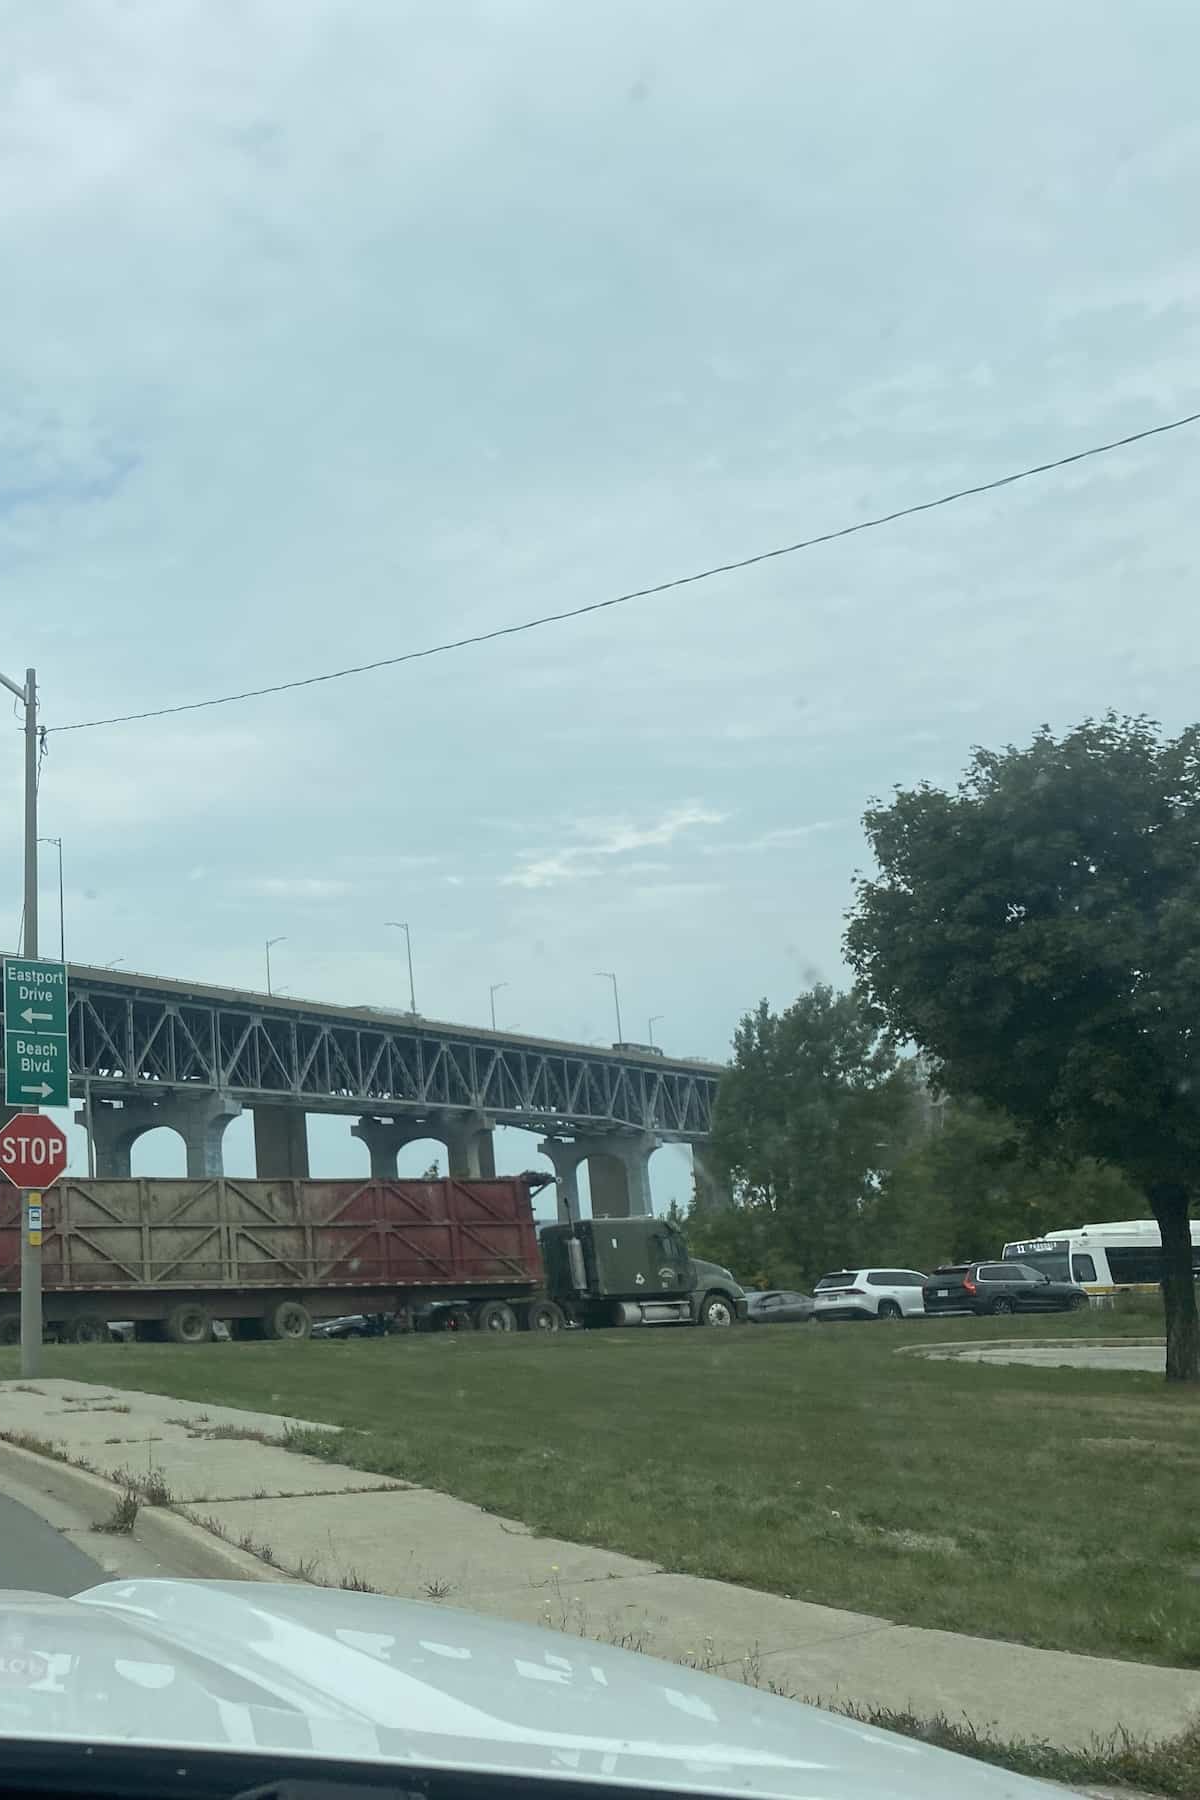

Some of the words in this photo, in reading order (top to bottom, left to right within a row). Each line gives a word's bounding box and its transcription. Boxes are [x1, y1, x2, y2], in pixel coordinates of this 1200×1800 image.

[7, 967, 64, 986] Eastport
[19, 986, 53, 1001] Drive
[16, 1040, 58, 1056] Beach
[21, 1058, 54, 1073] Blvd.
[2, 1137, 63, 1165] STOP
